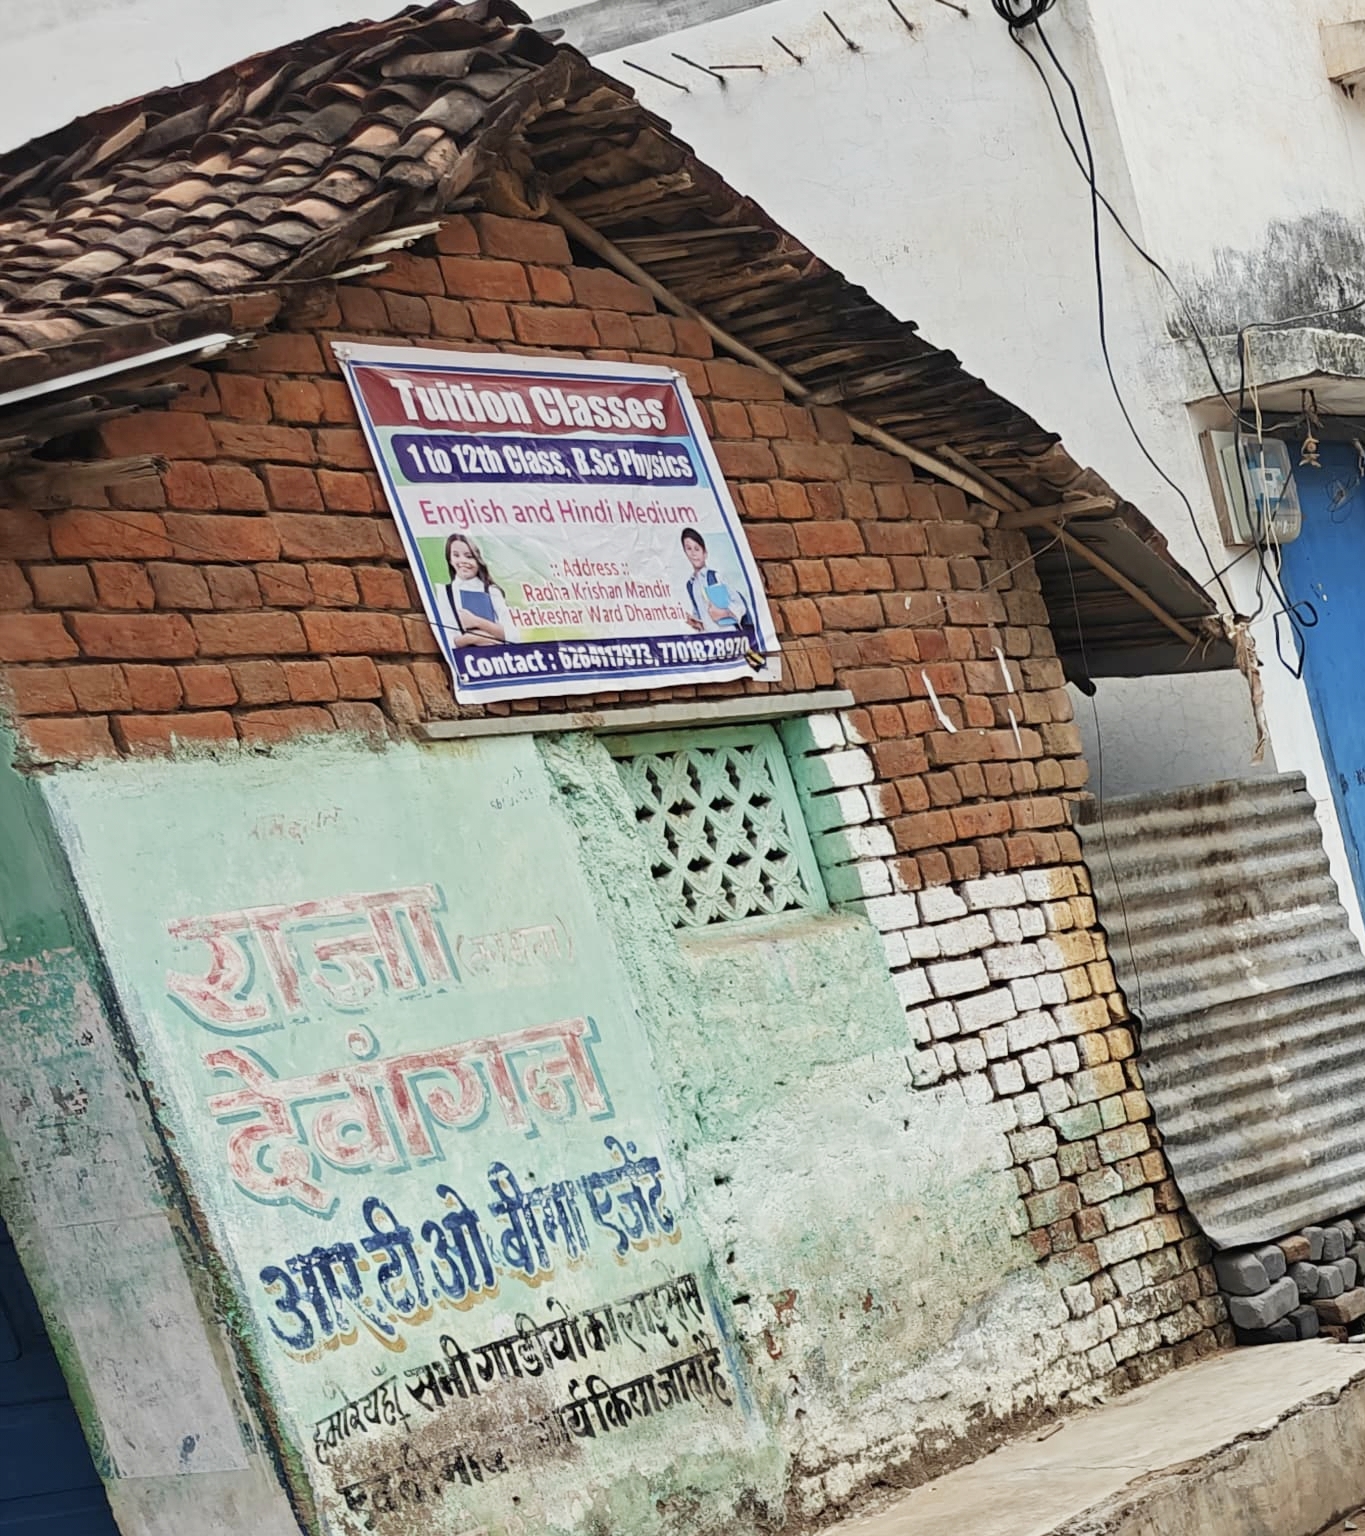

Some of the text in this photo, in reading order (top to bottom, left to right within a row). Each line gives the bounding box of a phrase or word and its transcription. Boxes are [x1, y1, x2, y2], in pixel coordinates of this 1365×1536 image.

[389, 378, 667, 431] Tuition Classes
[406, 443, 694, 481] 1 to 12th Class, B.Sc Physics
[419, 499, 699, 530] English and Hindi Medium
[563, 558, 620, 577] Address
[522, 579, 672, 602] Radha Krishan Mandir
[509, 601, 686, 628] Hatkeshar Ward Dhamtari
[464, 652, 546, 679] Contact
[165, 883, 452, 1032] राजा
[202, 1016, 614, 1219] देवांगन
